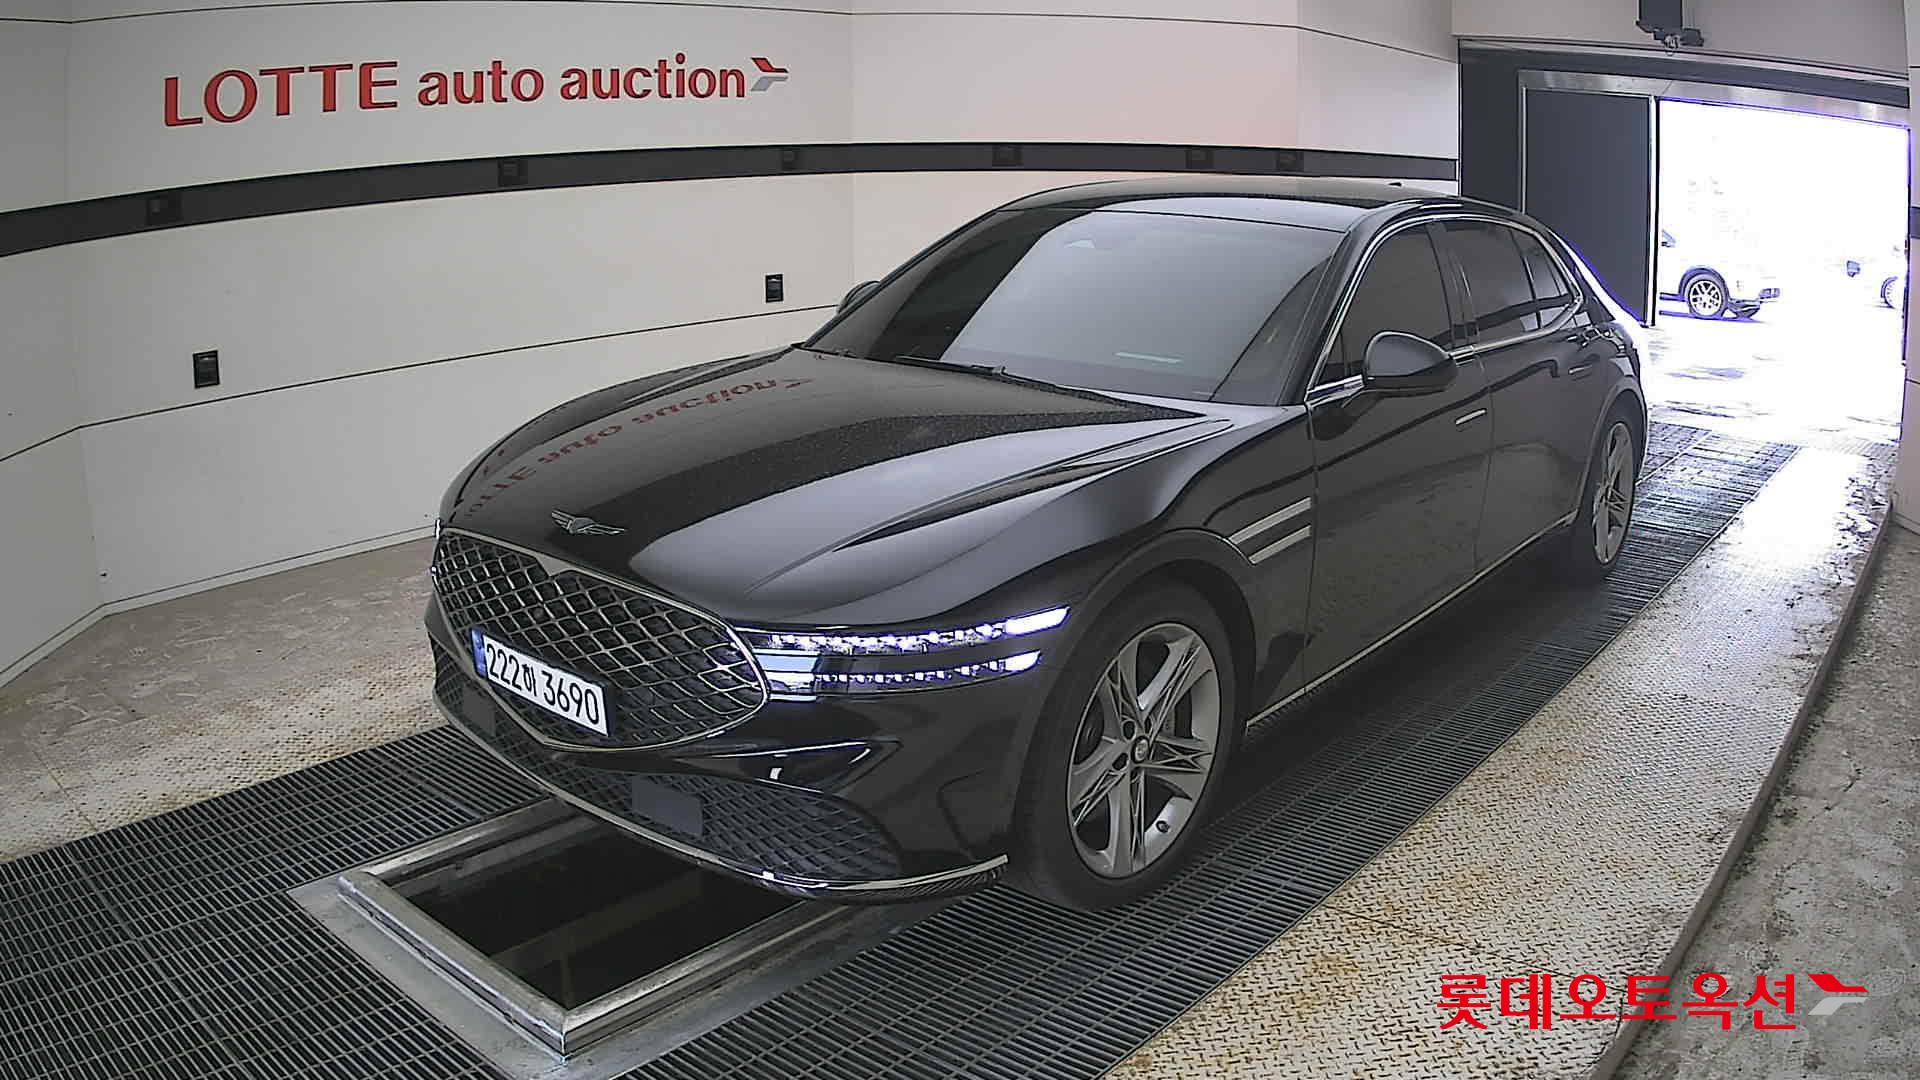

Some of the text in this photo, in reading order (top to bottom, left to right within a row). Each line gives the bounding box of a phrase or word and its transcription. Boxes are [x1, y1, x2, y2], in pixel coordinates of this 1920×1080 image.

[163, 52, 746, 128] LOTTE auto auction
[541, 670, 600, 725] 3690
